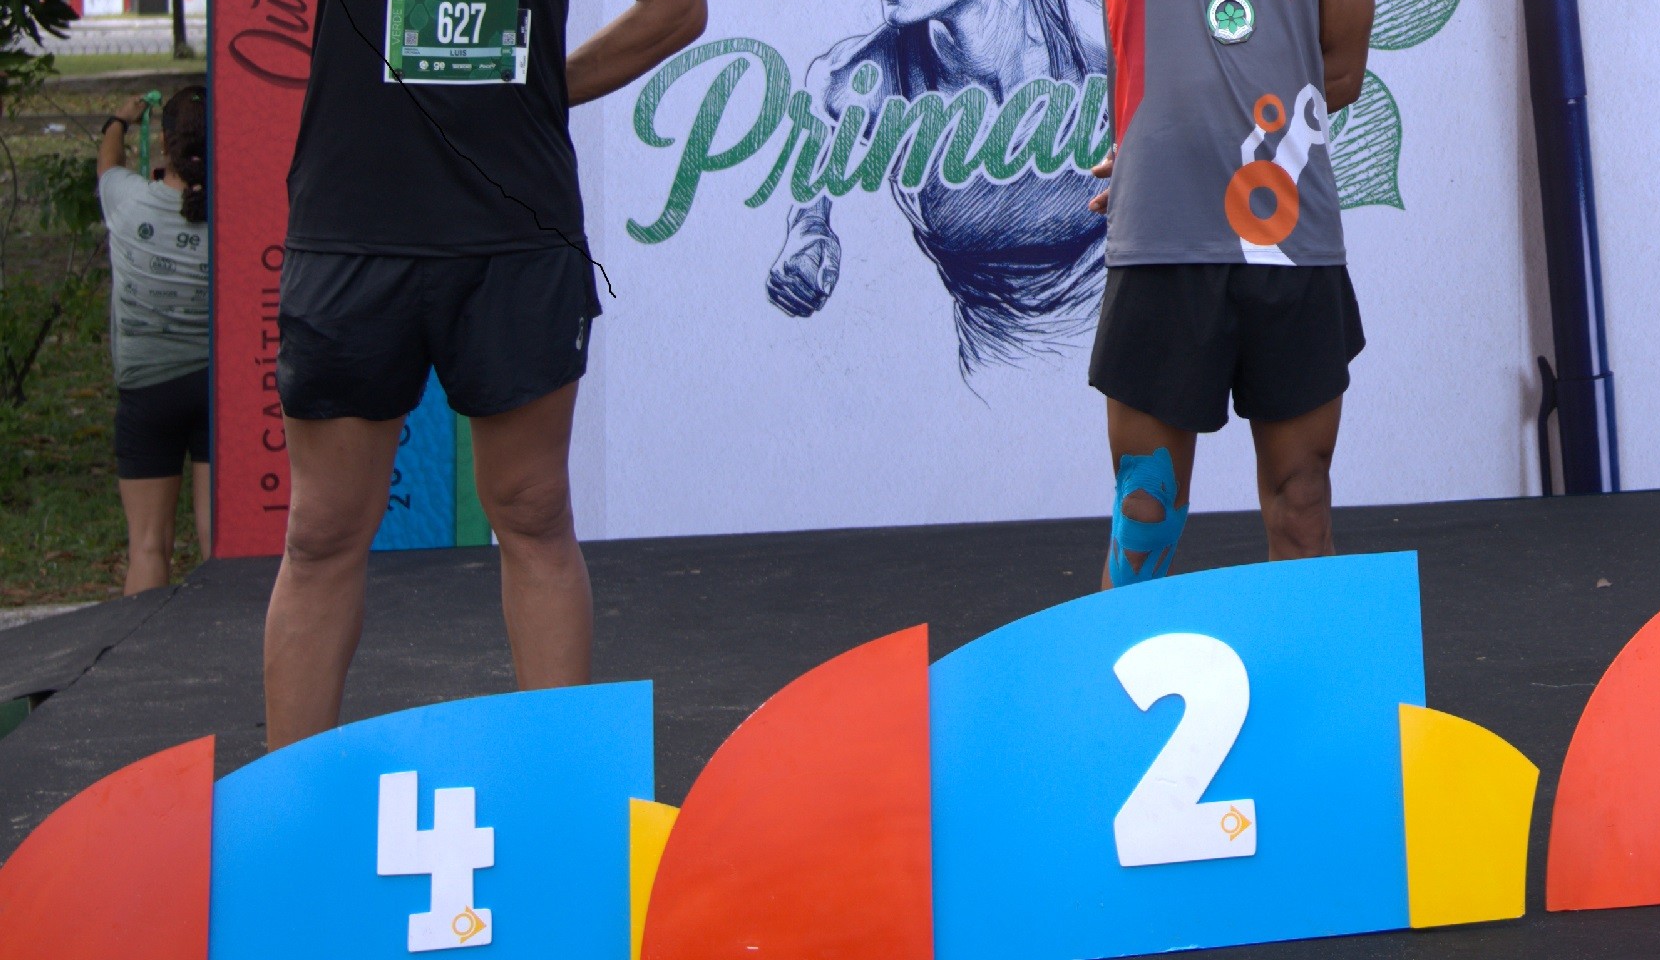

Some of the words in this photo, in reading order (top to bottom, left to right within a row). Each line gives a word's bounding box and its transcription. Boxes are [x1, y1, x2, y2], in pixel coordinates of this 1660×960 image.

[391, 9, 403, 46] VERDE
[438, 1, 487, 44] 627
[449, 49, 467, 57] LUIS
[176, 232, 201, 248] ge
[1113, 632, 1257, 867] 2
[377, 771, 494, 952] 4
